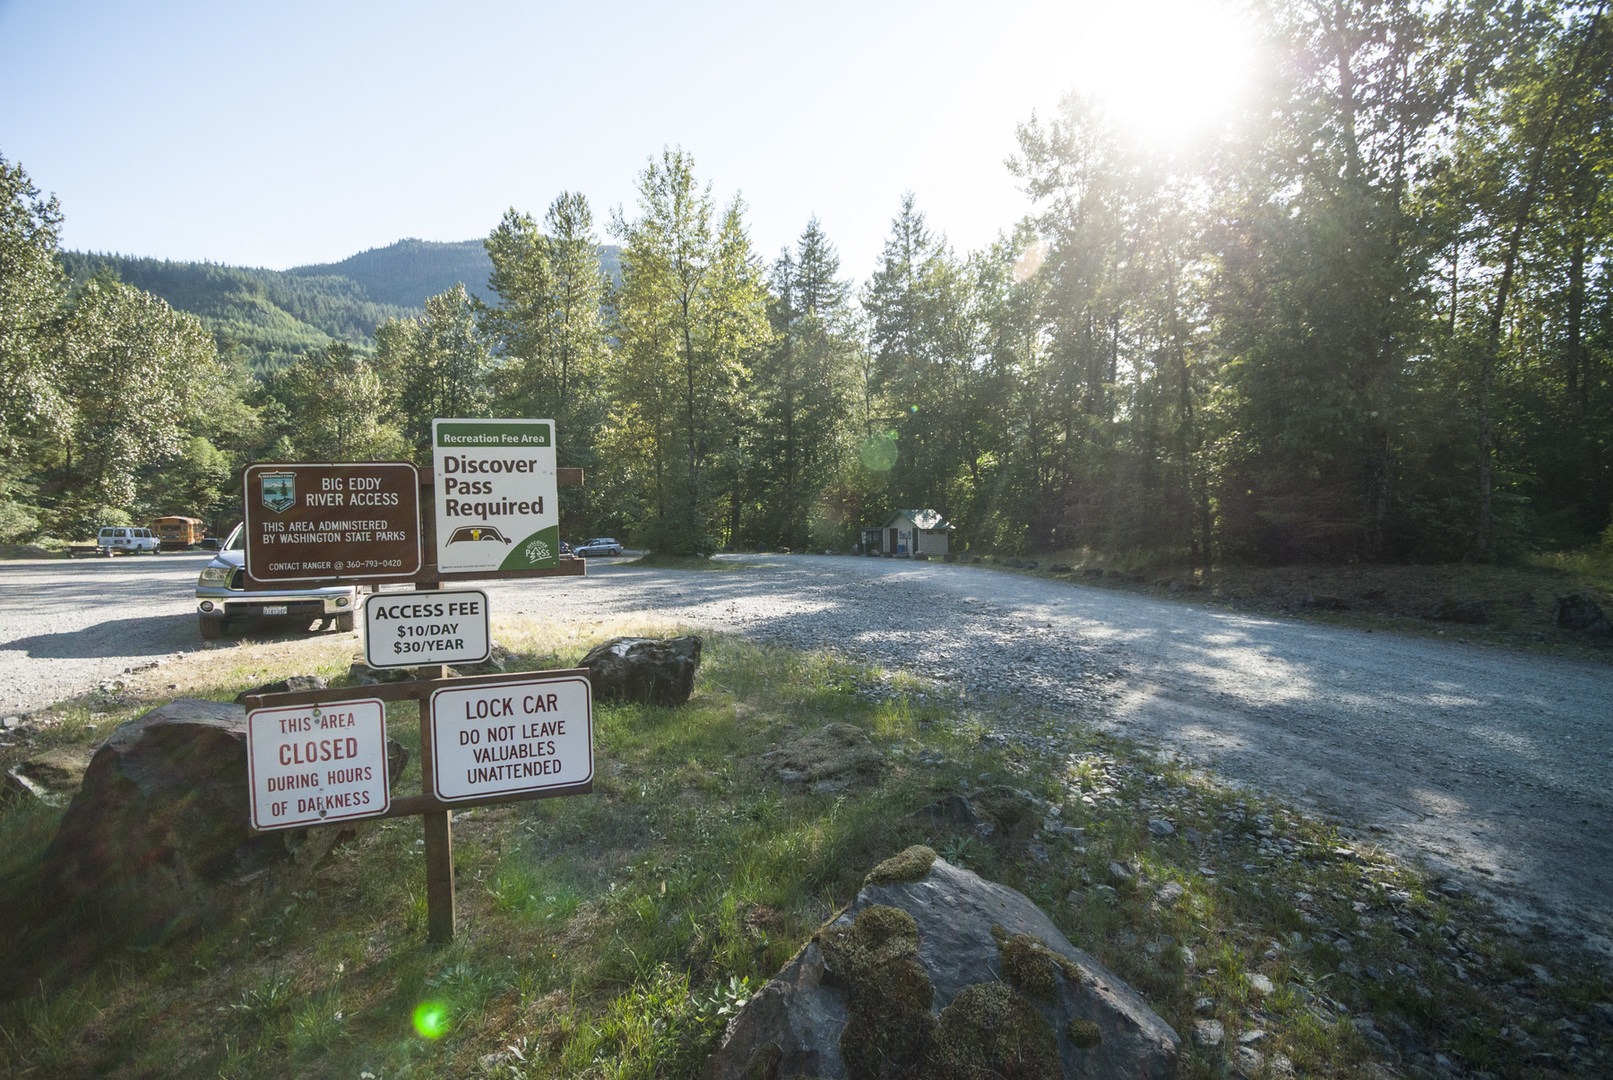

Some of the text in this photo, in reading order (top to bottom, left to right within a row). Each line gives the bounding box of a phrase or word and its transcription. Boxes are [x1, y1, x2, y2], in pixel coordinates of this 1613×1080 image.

[444, 434, 544, 443] Recreation Fee Area
[444, 454, 537, 474] Discover
[322, 478, 382, 490] BIG EDDY
[445, 478, 492, 495] Pass
[306, 492, 398, 506] RIVER ACCESS
[446, 496, 544, 520] Required
[262, 520, 388, 532] THIS AREA ADMINISTERED
[263, 531, 406, 544] BY WASHINGTON STATE PARKS
[269, 560, 402, 570] CONTACT RANGER @ 360-793-0420
[376, 602, 479, 620] ACCESS FEE
[398, 623, 459, 638] $10/DAY
[394, 638, 464, 654] $30/YEAR
[466, 694, 558, 720] LOCK CAR
[279, 712, 355, 734] THIS AREA
[460, 720, 566, 746] DO NOT LEAVE
[279, 737, 358, 766] CLOSED
[473, 740, 556, 764] VALUABLES
[268, 766, 372, 792] DURING HOURS
[468, 759, 562, 784] UNATTENDED
[272, 790, 370, 816] OF DARKNESS
